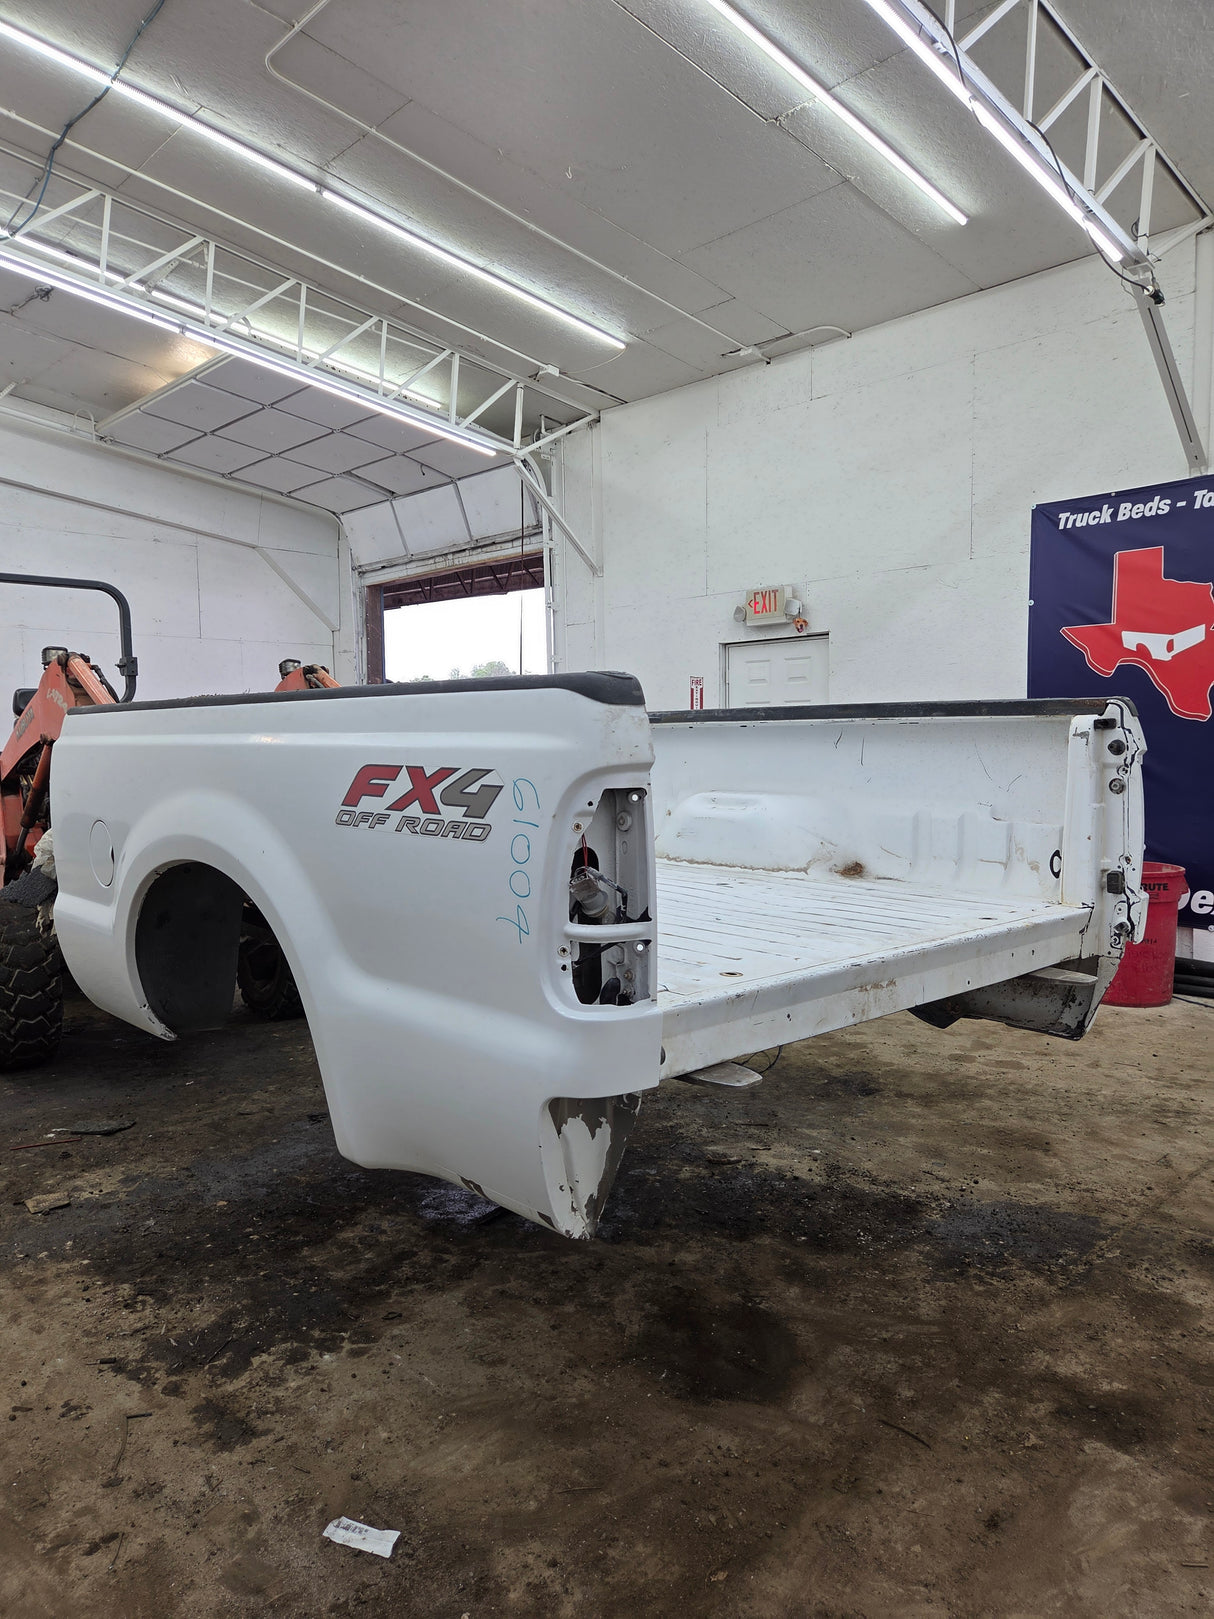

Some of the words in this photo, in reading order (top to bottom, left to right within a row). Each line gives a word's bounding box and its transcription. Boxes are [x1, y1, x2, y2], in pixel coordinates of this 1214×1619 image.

[1058, 504, 1114, 530] Truck
[1117, 495, 1171, 521] Beds
[753, 589, 779, 614] EXIT
[341, 764, 504, 819] FX4
[335, 810, 391, 829] OFF
[395, 816, 492, 842] ROAD
[496, 778, 541, 944] 61004
